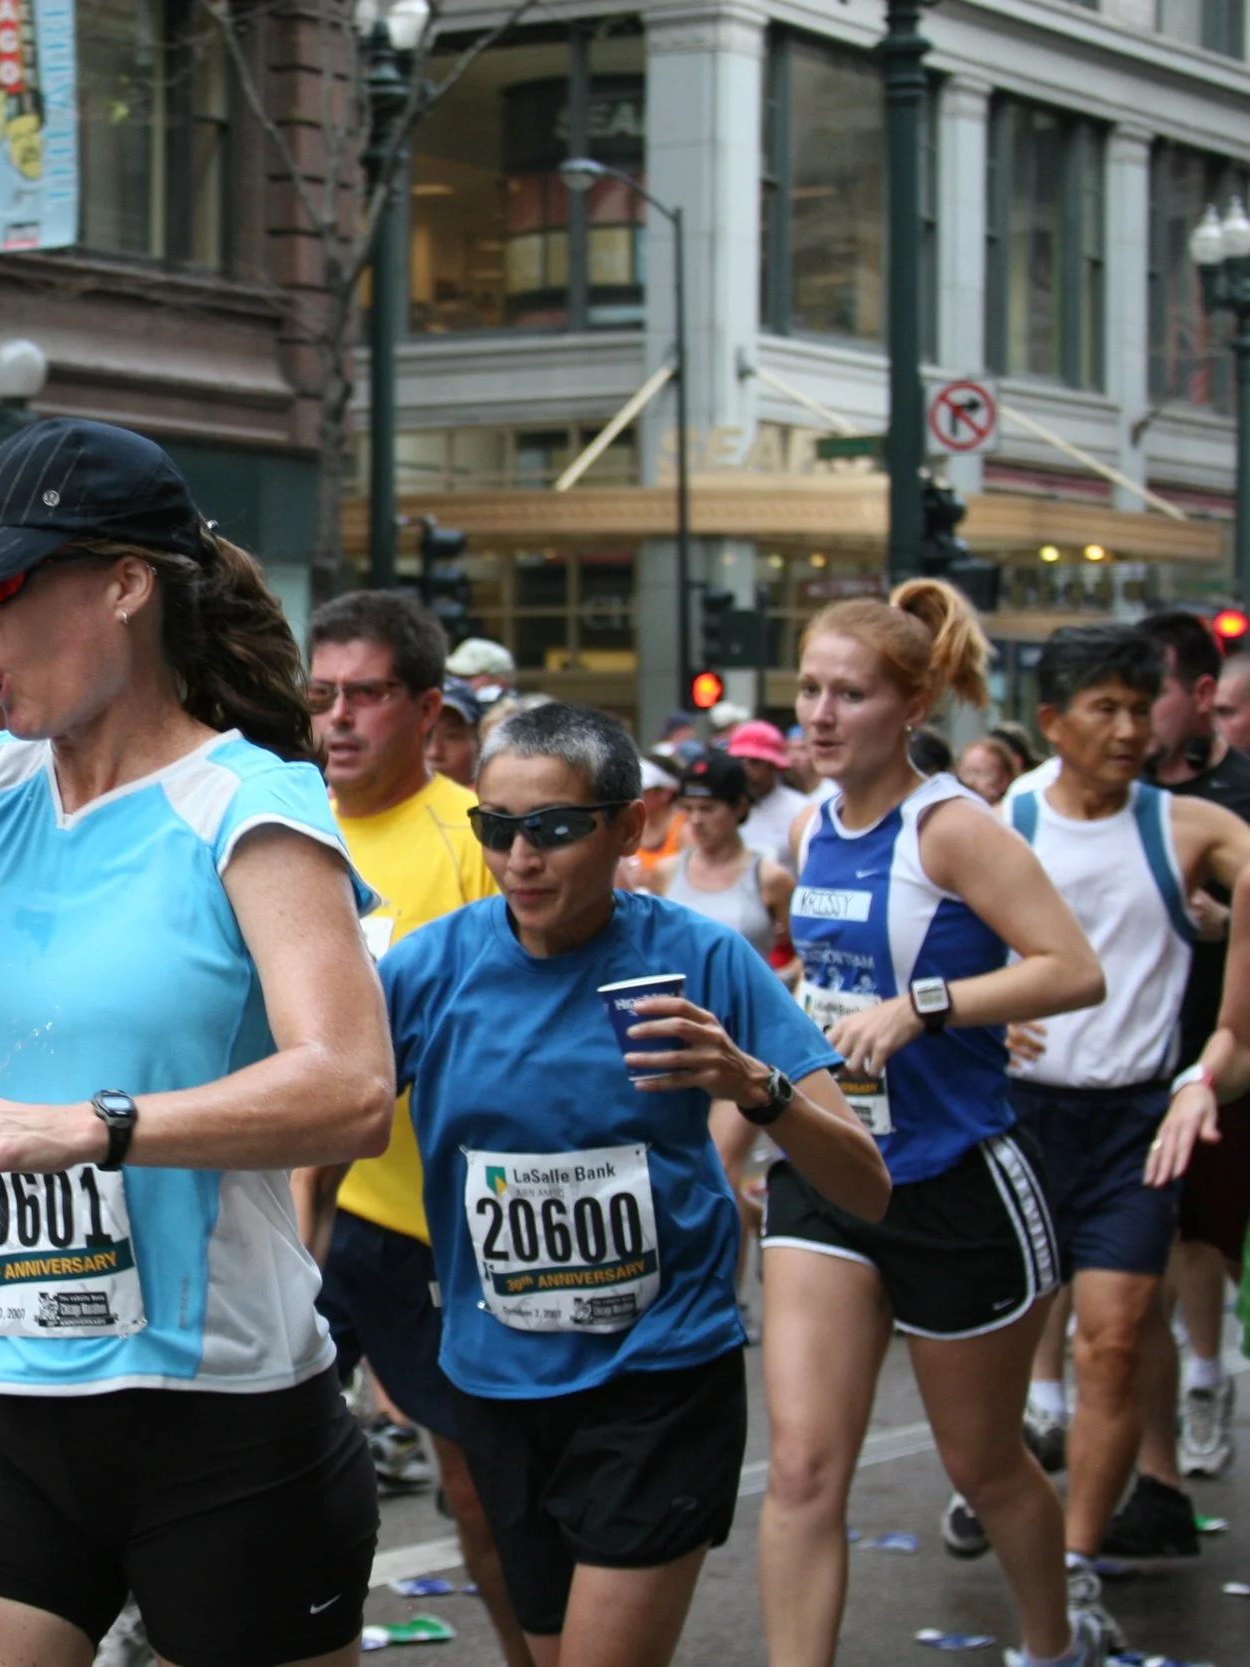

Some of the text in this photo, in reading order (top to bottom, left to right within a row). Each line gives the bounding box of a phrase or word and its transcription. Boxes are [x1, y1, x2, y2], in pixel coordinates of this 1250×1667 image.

[513, 1163, 616, 1184] LaSalle Bank
[476, 1191, 644, 1265] 20600
[4, 1252, 118, 1280] ANNIVERSARY
[505, 1260, 647, 1292] 30th ANNIVERSARY
